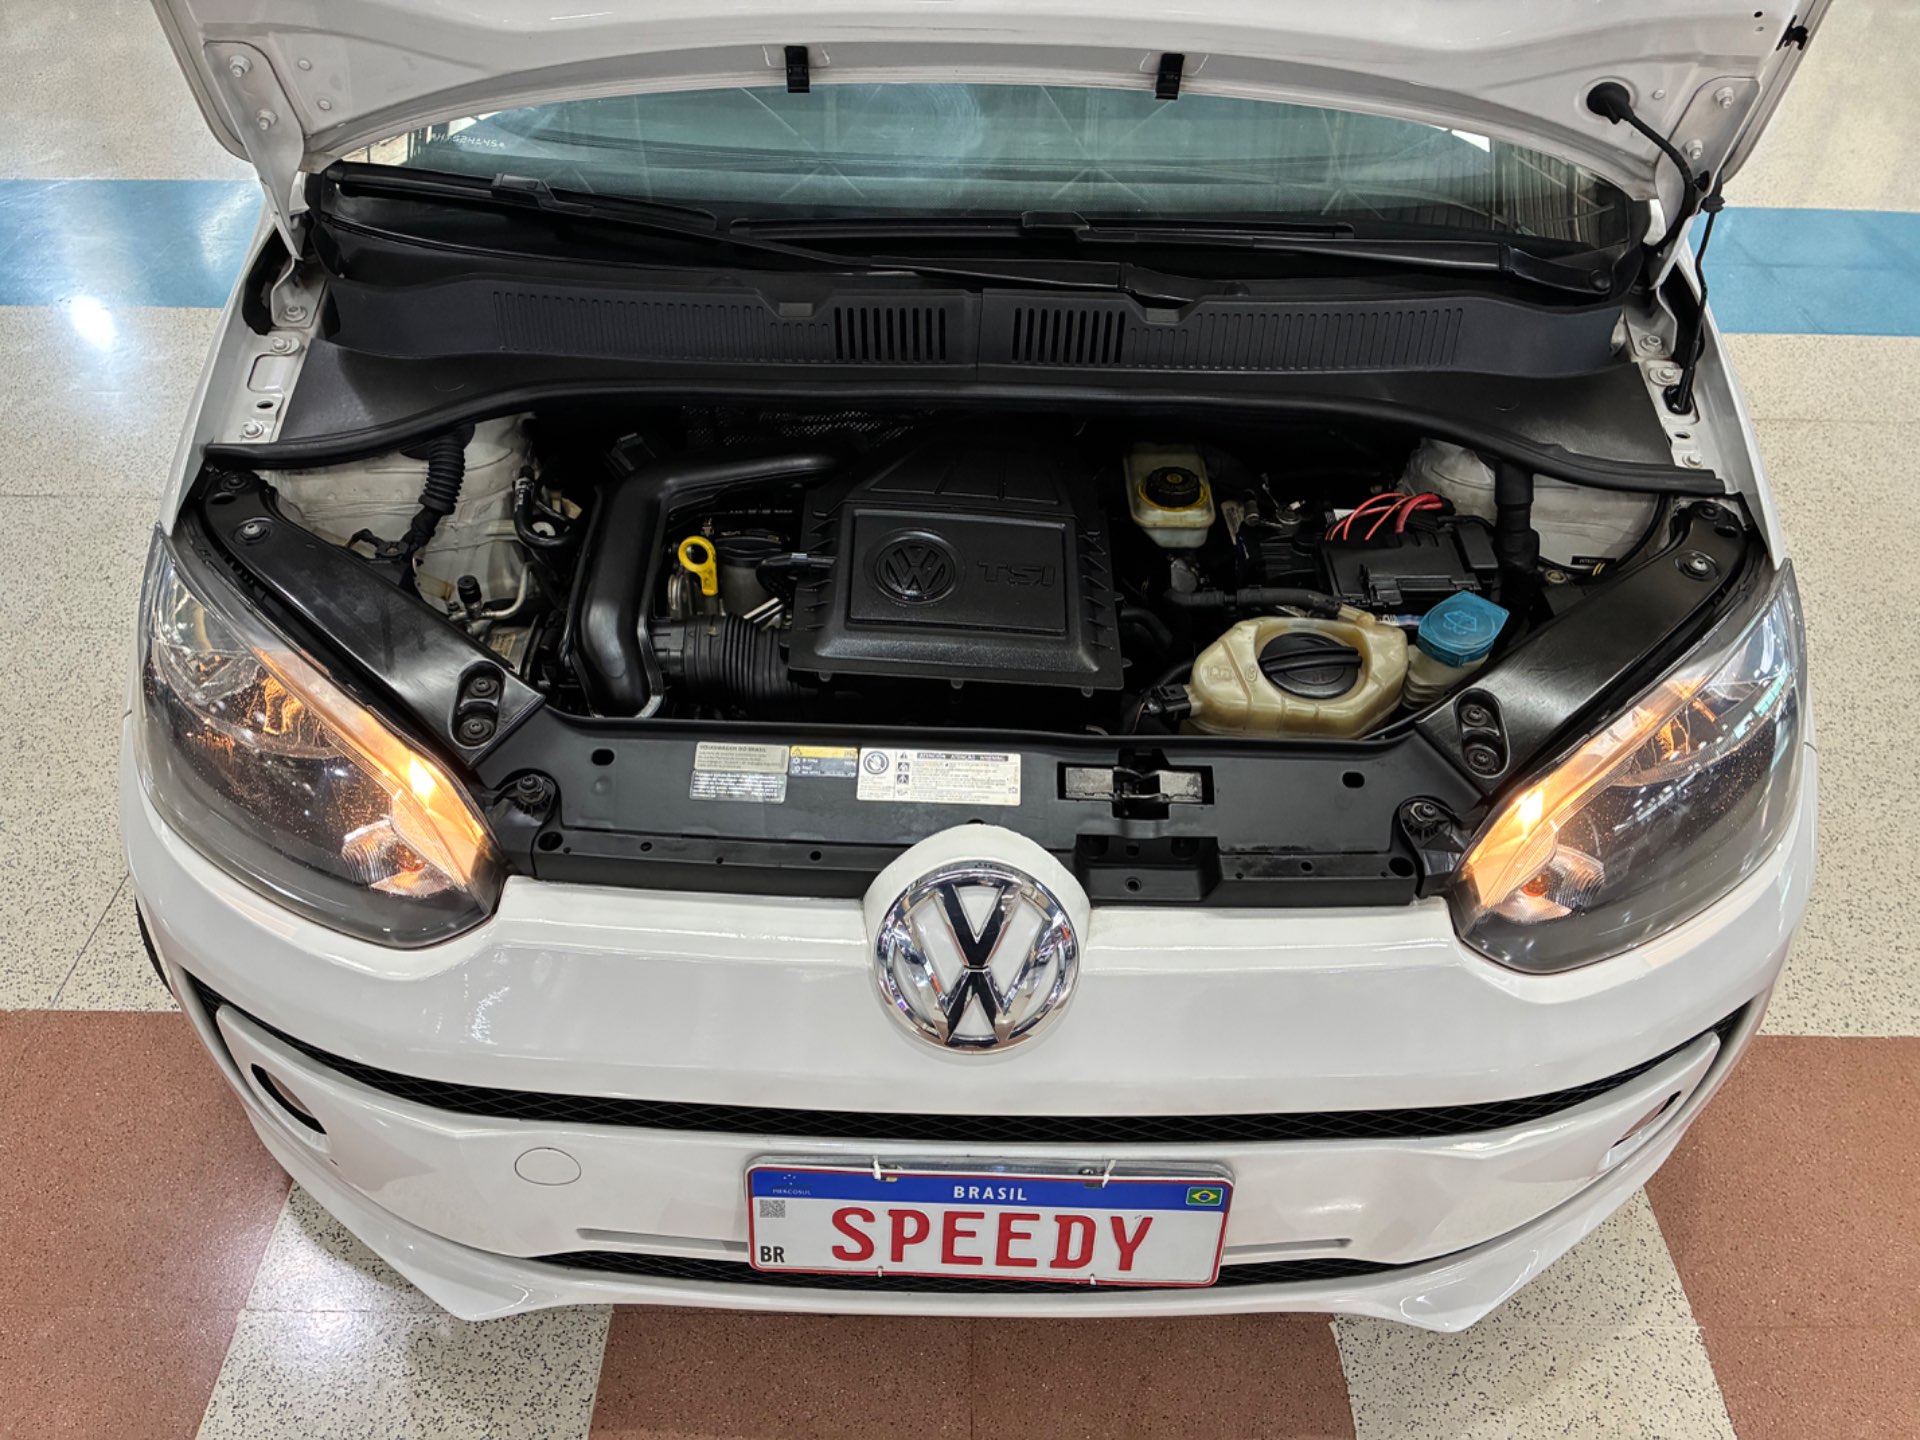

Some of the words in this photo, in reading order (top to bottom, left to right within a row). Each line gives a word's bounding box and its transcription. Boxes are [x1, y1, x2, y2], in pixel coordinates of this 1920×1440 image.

[977, 562, 1056, 587] TSI
[953, 1185, 1028, 1201] BRASIL
[831, 1206, 1154, 1271] SPEEDY
[760, 1245, 785, 1263] BR
